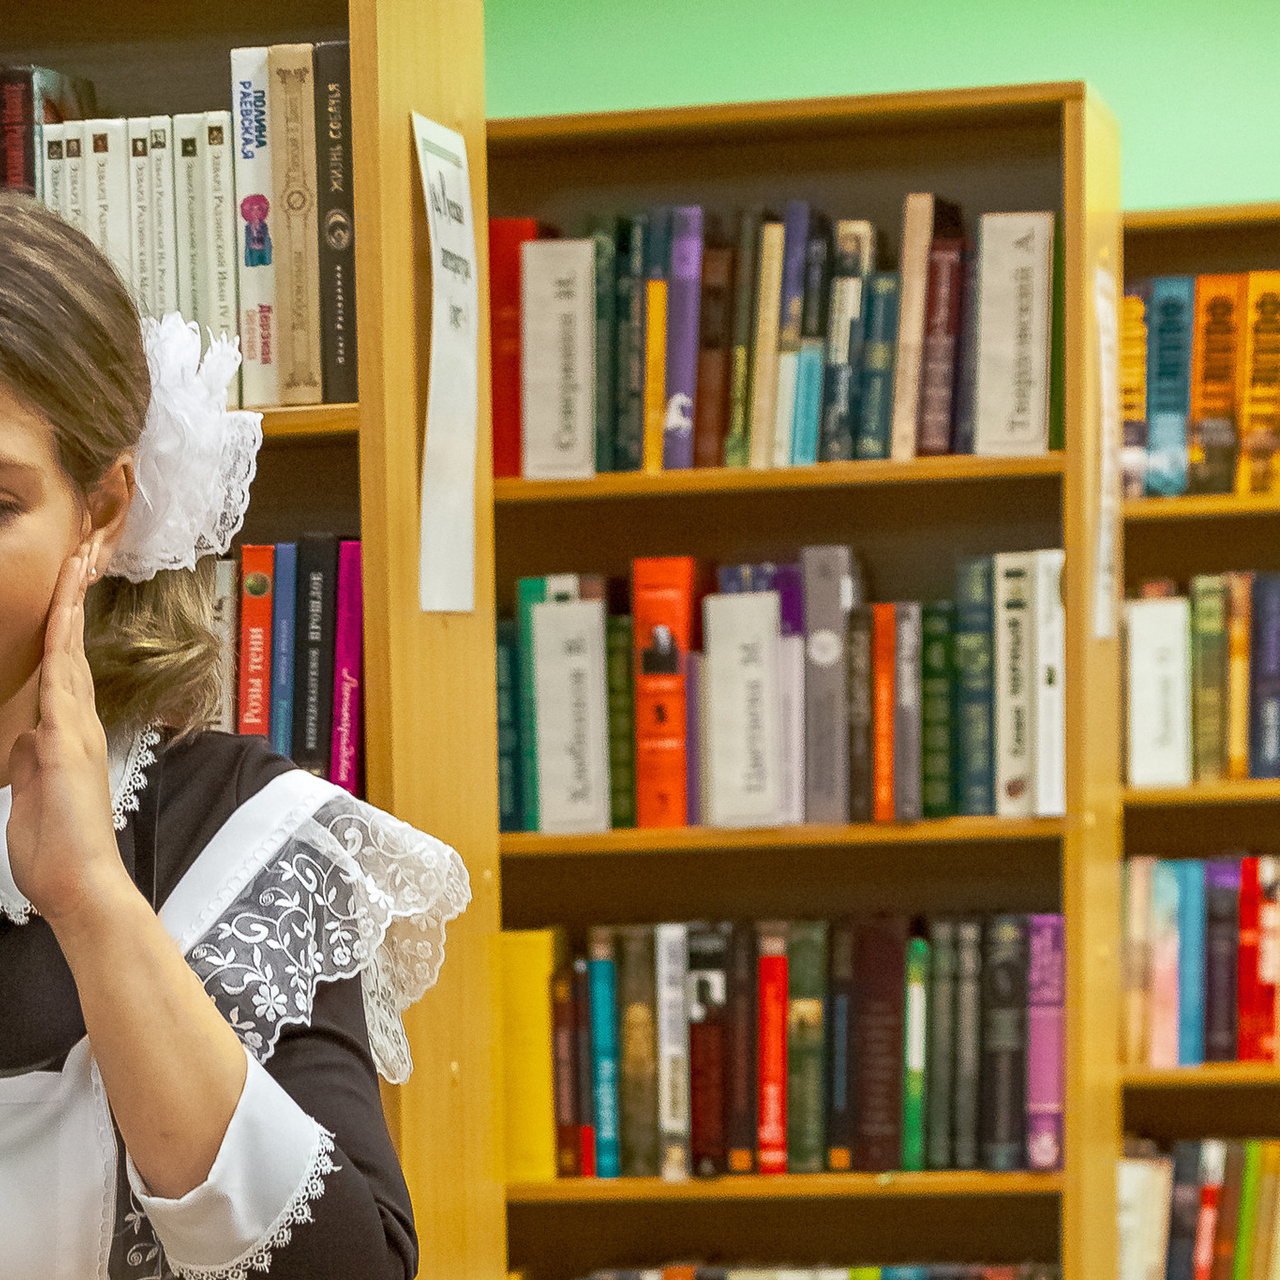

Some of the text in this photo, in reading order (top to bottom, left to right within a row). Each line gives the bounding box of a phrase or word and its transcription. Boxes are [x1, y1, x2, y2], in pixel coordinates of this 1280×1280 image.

[239, 81, 255, 160] РАЕВСКАЯ
[253, 90, 268, 148] ПОЛИНА
[307, 571, 323, 641] ПРОШЛОЕ
[244, 627, 264, 724] Розы тени
